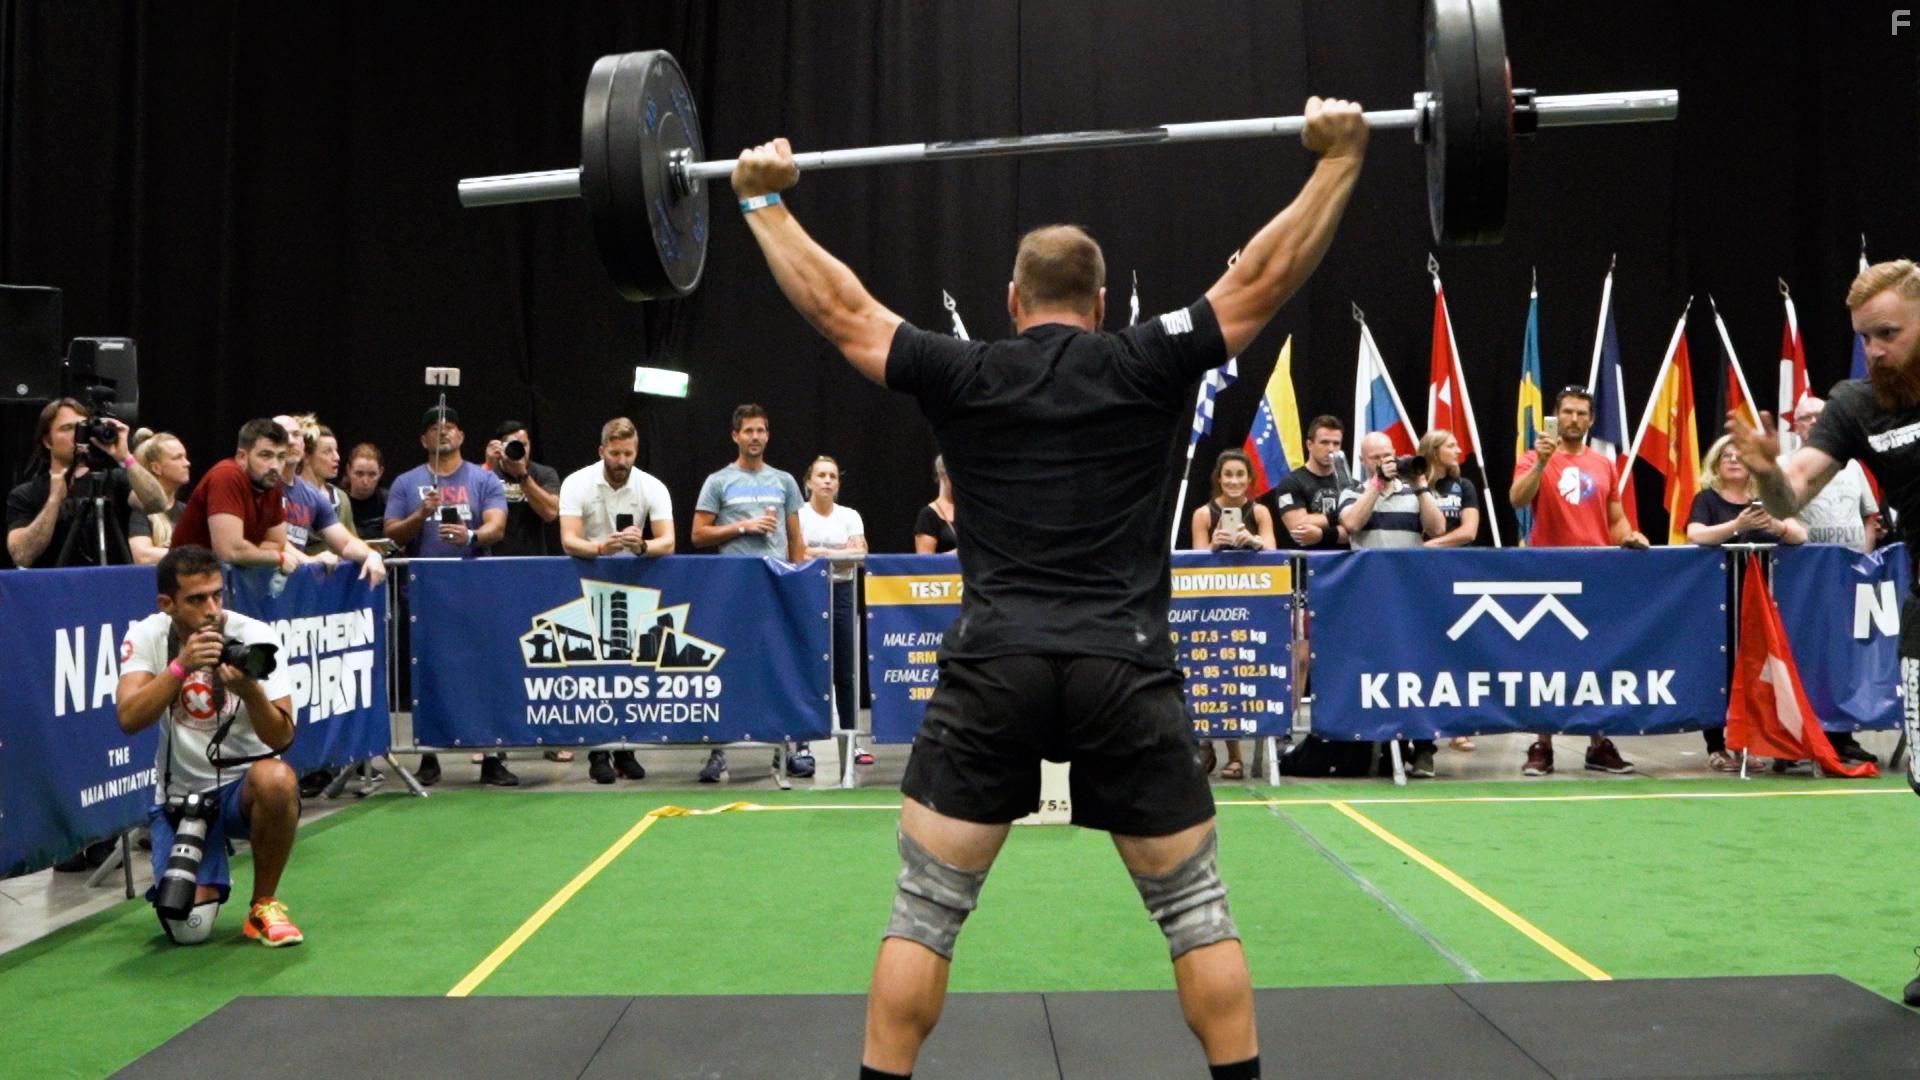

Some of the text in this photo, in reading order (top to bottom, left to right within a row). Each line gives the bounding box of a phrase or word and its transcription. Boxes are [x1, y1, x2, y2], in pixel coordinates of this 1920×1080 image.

[909, 581, 952, 598] TEST
[1171, 572, 1272, 592] NDIVIDUALS
[1167, 607, 1251, 623] QUAT LADDER:
[883, 632, 917, 647] MALE
[1170, 631, 1179, 644] 0
[1231, 629, 1248, 643] 95
[1250, 629, 1267, 645] kg
[908, 651, 937, 664] 5RM
[1191, 648, 1208, 661] 60
[1220, 647, 1237, 661] 65
[1239, 646, 1256, 662] kg
[55, 620, 141, 717] NA
[884, 669, 930, 683] FEMALE
[1203, 665, 1220, 678] 95
[1232, 664, 1268, 677] 102.5
[1270, 663, 1287, 678] kg
[288, 650, 375, 725] PIRIT
[524, 675, 722, 700] WORLDS 2019
[1192, 683, 1208, 696] 65
[1221, 683, 1237, 695] 70
[1240, 682, 1257, 697] kg
[1360, 669, 1678, 709] KRAFTMARK
[527, 699, 720, 726] MALMÖ, SWEDEN
[1193, 701, 1229, 714] 102.5
[1241, 700, 1265, 712] 110
[1267, 699, 1284, 715] kg
[1222, 718, 1238, 731] 75
[1240, 717, 1257, 733] kg
[108, 747, 130, 767] THE
